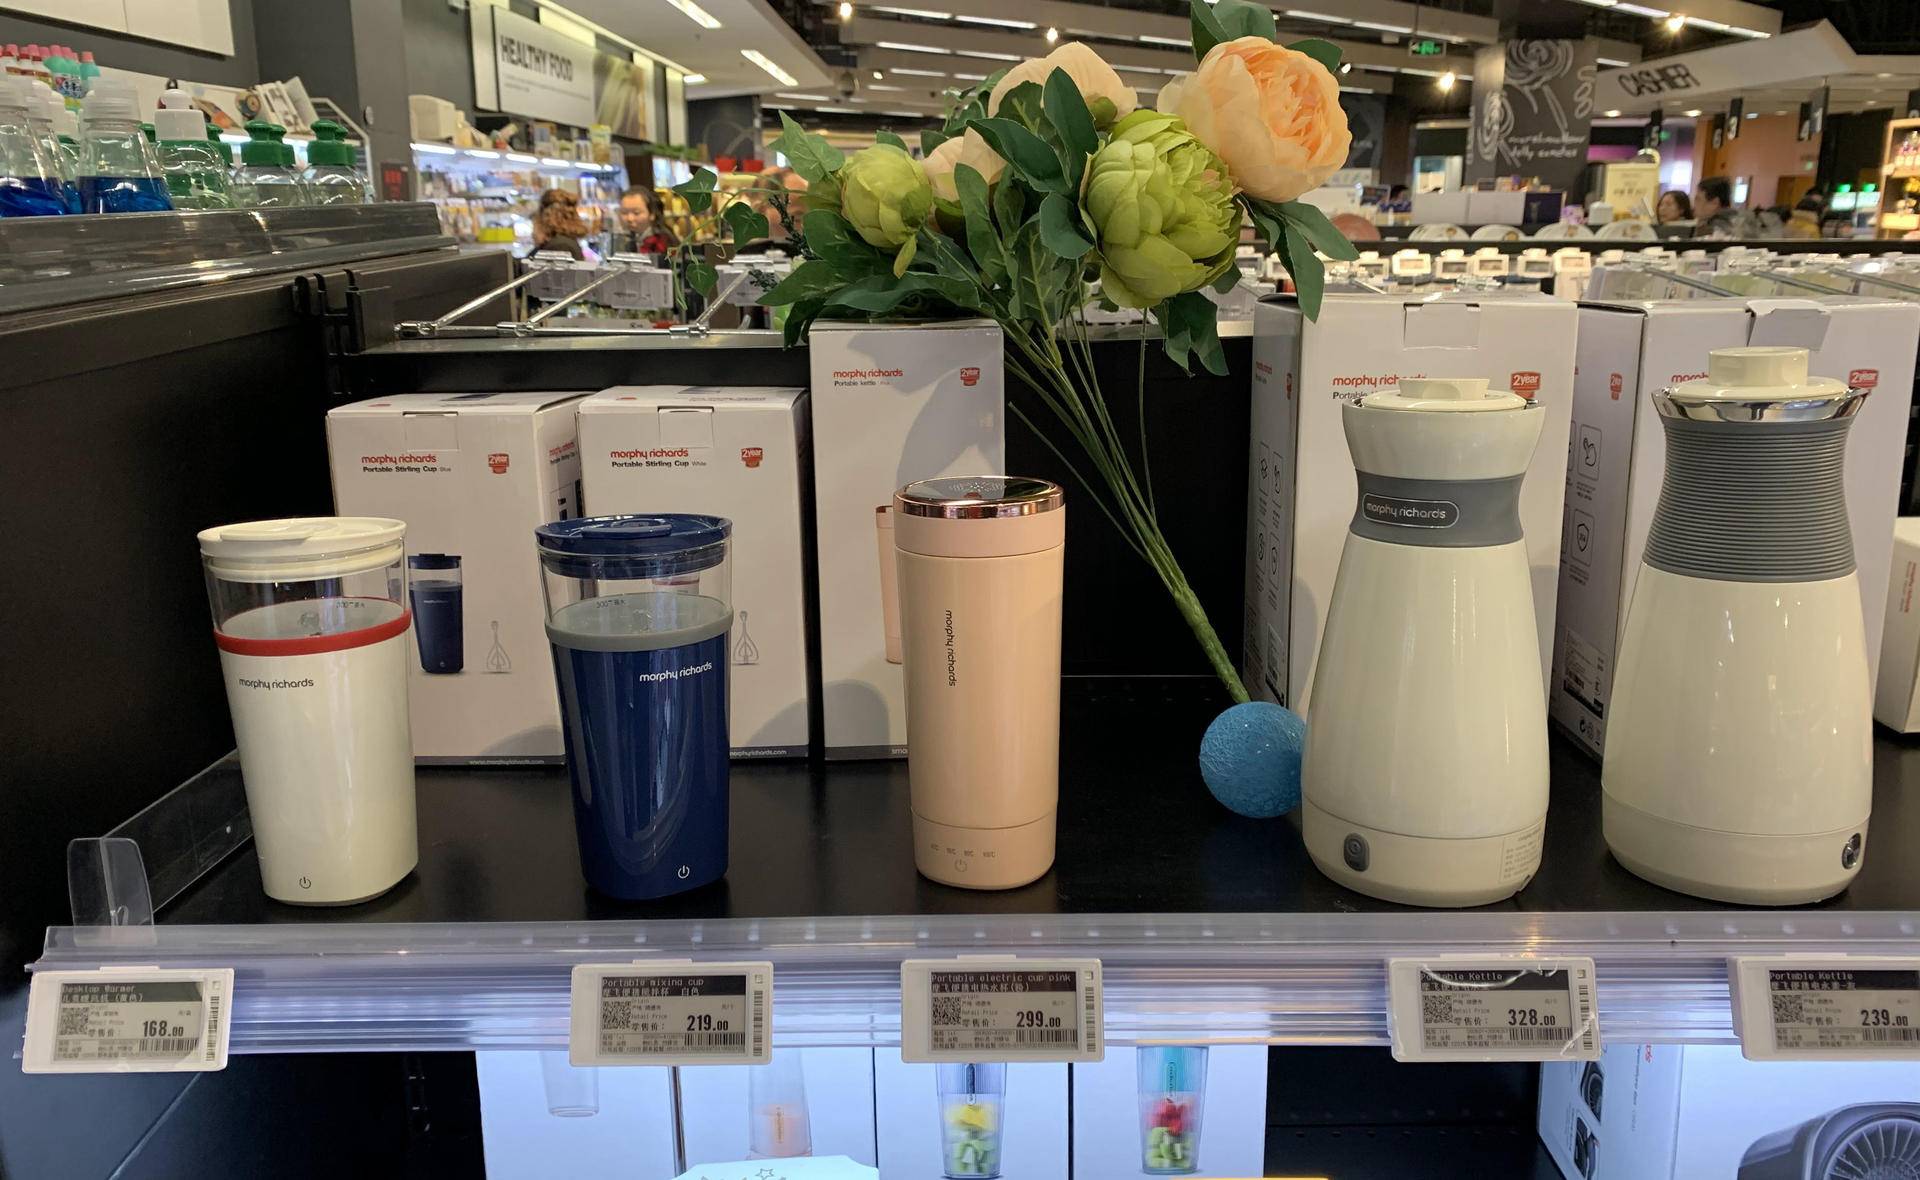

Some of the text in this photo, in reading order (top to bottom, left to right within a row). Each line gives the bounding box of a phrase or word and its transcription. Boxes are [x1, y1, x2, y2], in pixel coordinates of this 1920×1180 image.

[500, 35, 574, 82] HEALTHY FOOD
[833, 368, 904, 379] morphy richards
[1332, 374, 1377, 388] morphy
[361, 454, 437, 465] morphy richards
[611, 449, 689, 460] morphy richards
[422, 465, 437, 474] Cup
[645, 460, 672, 468] Stirling
[1366, 502, 1446, 519] morphy richards
[945, 610, 957, 687] morphy richards
[639, 662, 712, 682] morphy richards
[239, 677, 314, 690] morphy richards
[603, 978, 645, 986] Portable
[688, 979, 704, 987] cup
[932, 974, 974, 983] Portable
[980, 975, 1022, 983] electric
[1469, 972, 1503, 981] Kettle
[1770, 972, 1853, 980] Portable Kettle
[687, 1015, 728, 1031] 219.00
[1016, 1011, 1061, 1028] 299.00
[1508, 1009, 1556, 1026] 328.00
[1861, 1009, 1909, 1026] 239.00
[143, 1020, 184, 1037] 168.00
